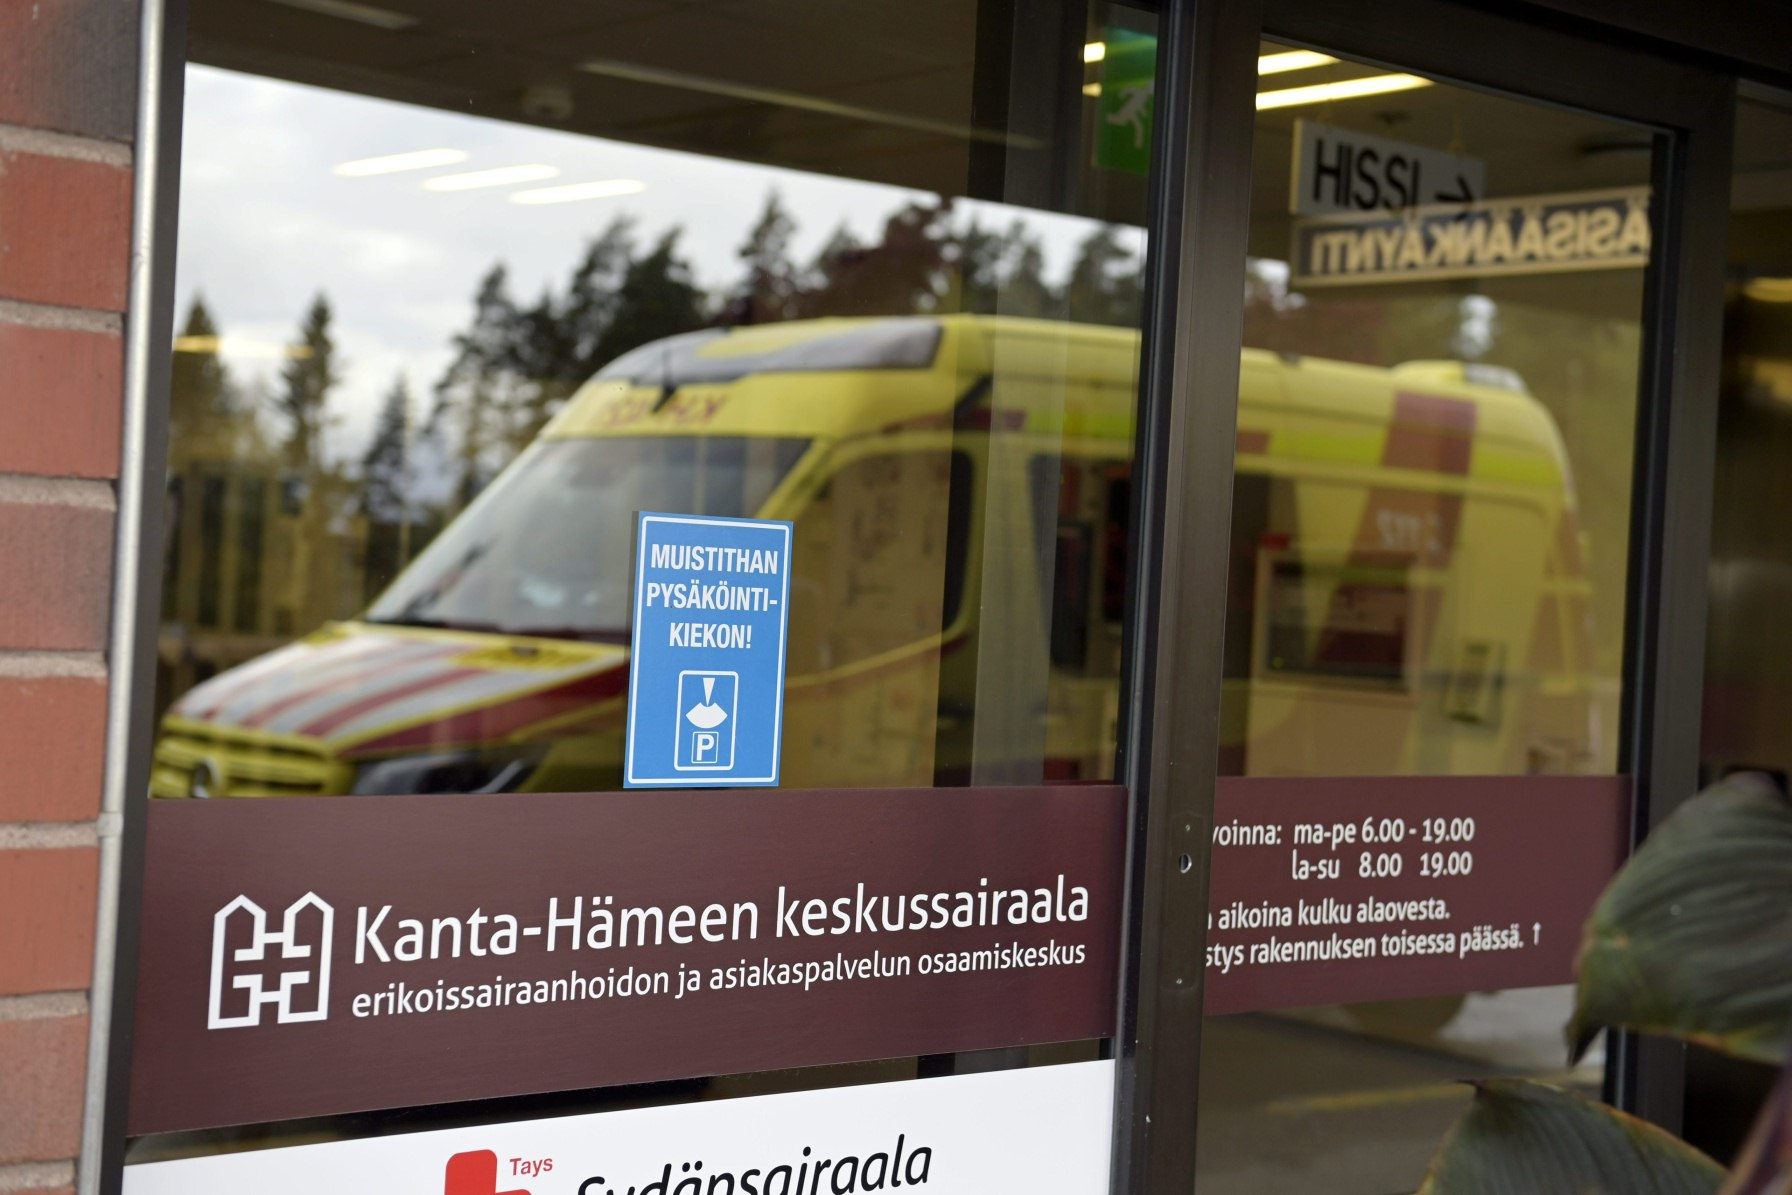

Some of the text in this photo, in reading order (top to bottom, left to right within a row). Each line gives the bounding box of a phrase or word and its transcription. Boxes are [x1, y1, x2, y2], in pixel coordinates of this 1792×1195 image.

[1312, 138, 1421, 212] HISSI
[650, 543, 778, 575] MUISTITHAN
[646, 579, 778, 612] PYSÄKÖINTI-
[669, 622, 752, 649] KIEKON!
[1293, 821, 1356, 850] ma-pe
[1361, 817, 1405, 843] 6.00
[1421, 817, 1475, 842] 19.00
[1292, 849, 1473, 880] la-su 8.00 19.00
[354, 874, 1089, 964] Kanta-Hämeen keskussairaala
[1218, 901, 1293, 930] aikoina
[1297, 897, 1352, 926] kulku
[1356, 896, 1451, 922] alaovesta.
[1250, 932, 1376, 965] rakennuksen
[1381, 930, 1455, 957] toisessa
[1459, 922, 1524, 959] päässä.
[352, 939, 1086, 1018] erikoissairaanhoidon ja asiakaspalvelun osaamiskeskus
[509, 1156, 554, 1178] Tays
[577, 1134, 933, 1195] dänsairaala
